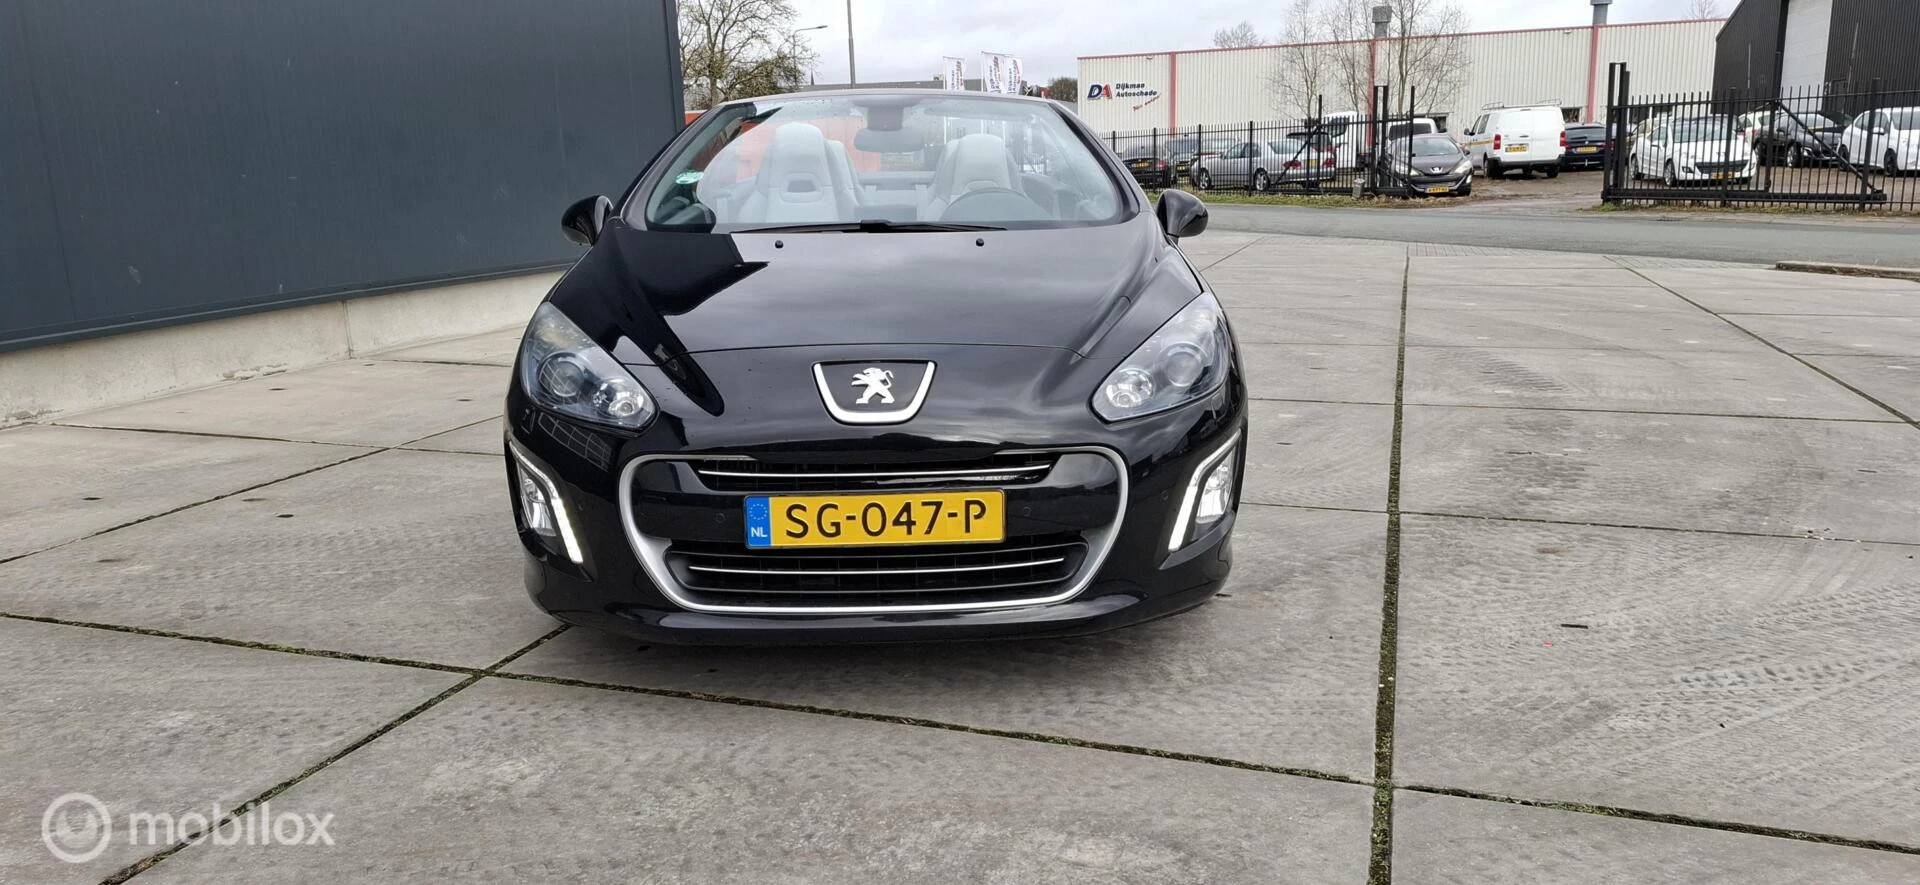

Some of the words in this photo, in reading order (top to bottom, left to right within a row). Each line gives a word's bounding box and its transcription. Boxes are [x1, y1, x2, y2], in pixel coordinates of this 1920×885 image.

[1087, 84, 1112, 99] DA
[785, 499, 987, 538] SG-047-P
[751, 526, 768, 538] NL
